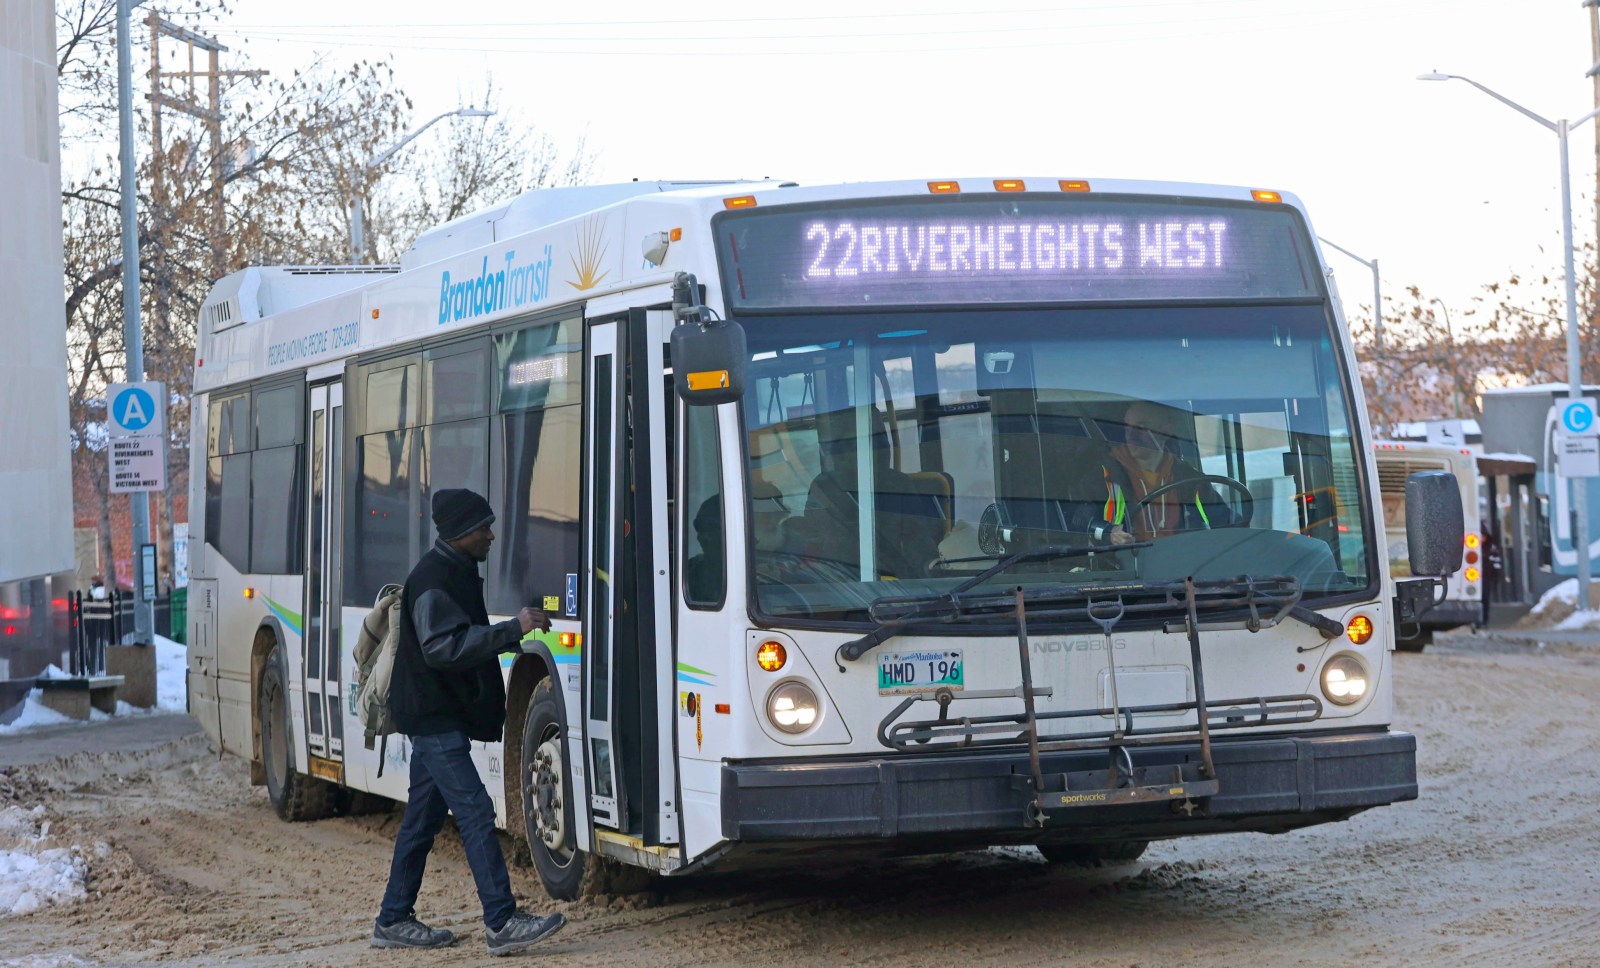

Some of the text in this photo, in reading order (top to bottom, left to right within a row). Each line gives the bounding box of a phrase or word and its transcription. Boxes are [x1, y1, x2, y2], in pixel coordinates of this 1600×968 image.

[1138, 222, 1227, 269] WEST
[268, 321, 358, 367] PEOPLE MOVING PEOPLE 729-2300
[122, 393, 148, 425] A
[1569, 406, 1587, 429] C
[115, 472, 133, 480] ROUTE
[115, 480, 141, 488] VICTORIA
[915, 652, 943, 661] Manitoba
[882, 660, 960, 685] HMD 196
[1061, 792, 1106, 804] sportworks
